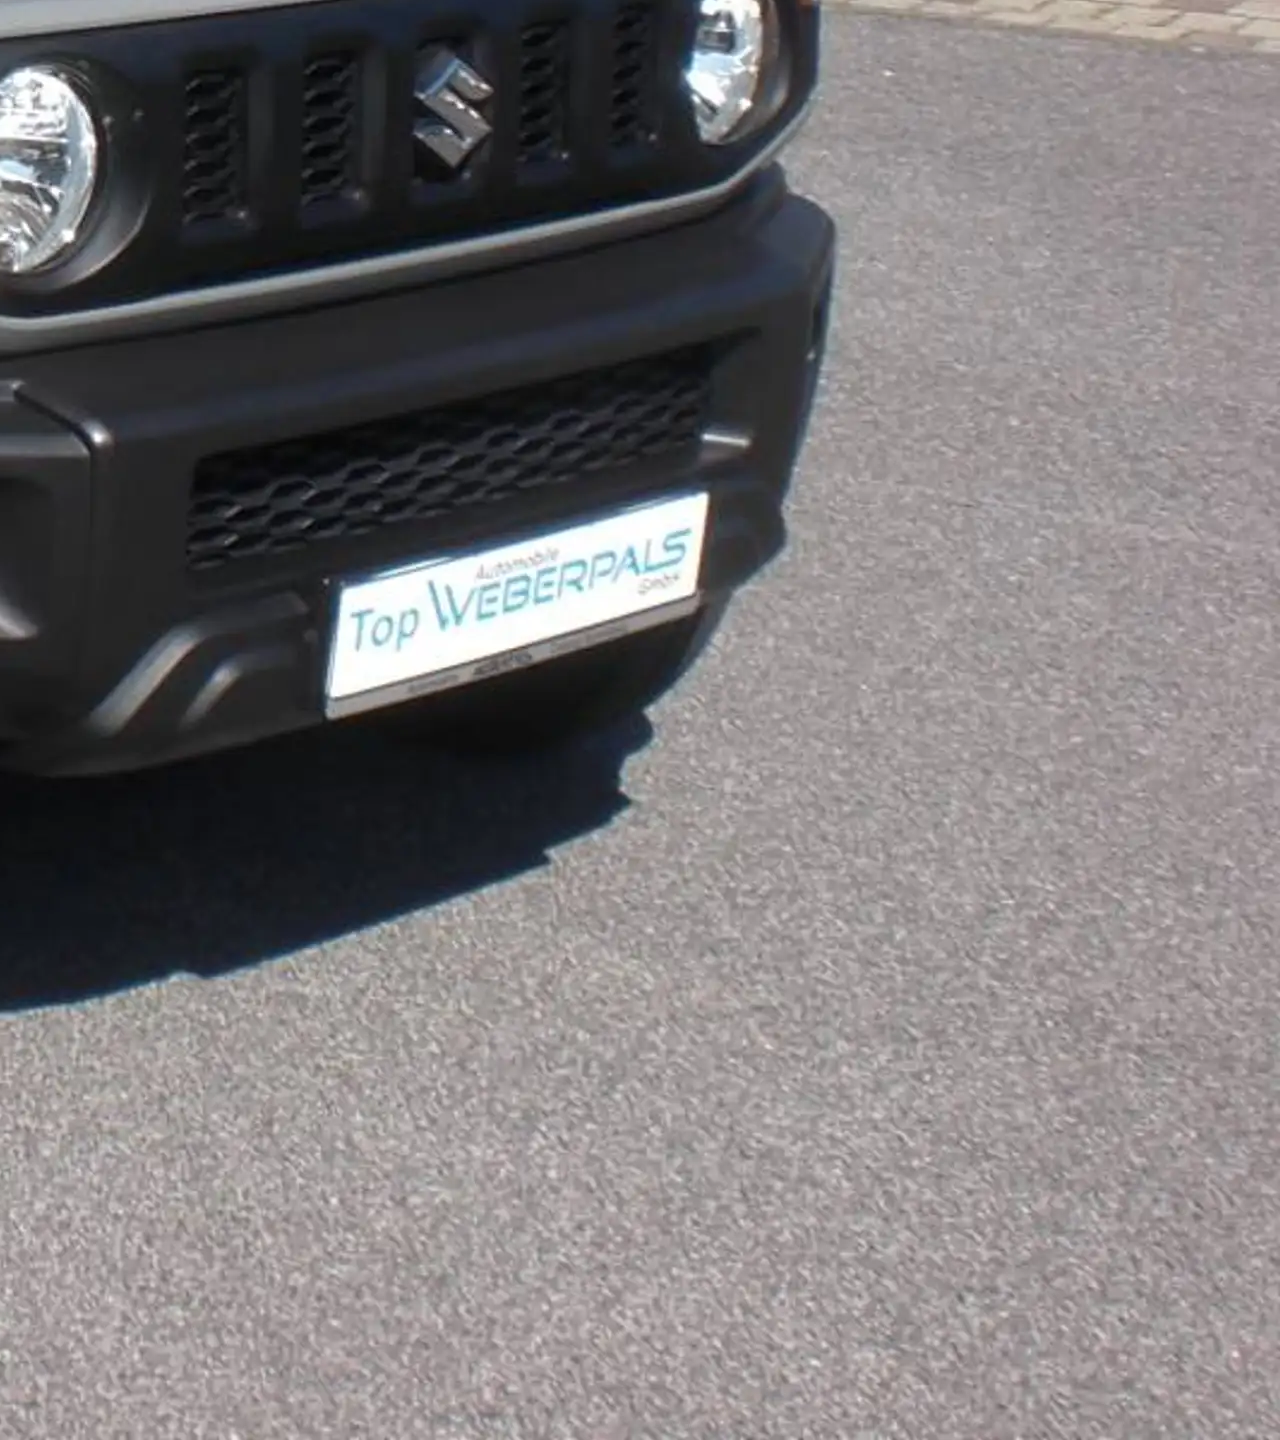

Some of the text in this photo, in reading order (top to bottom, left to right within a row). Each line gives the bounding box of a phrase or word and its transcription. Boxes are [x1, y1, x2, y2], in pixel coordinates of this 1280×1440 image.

[350, 528, 692, 653] Top WEBERPALS
[474, 547, 560, 582] Automobile
